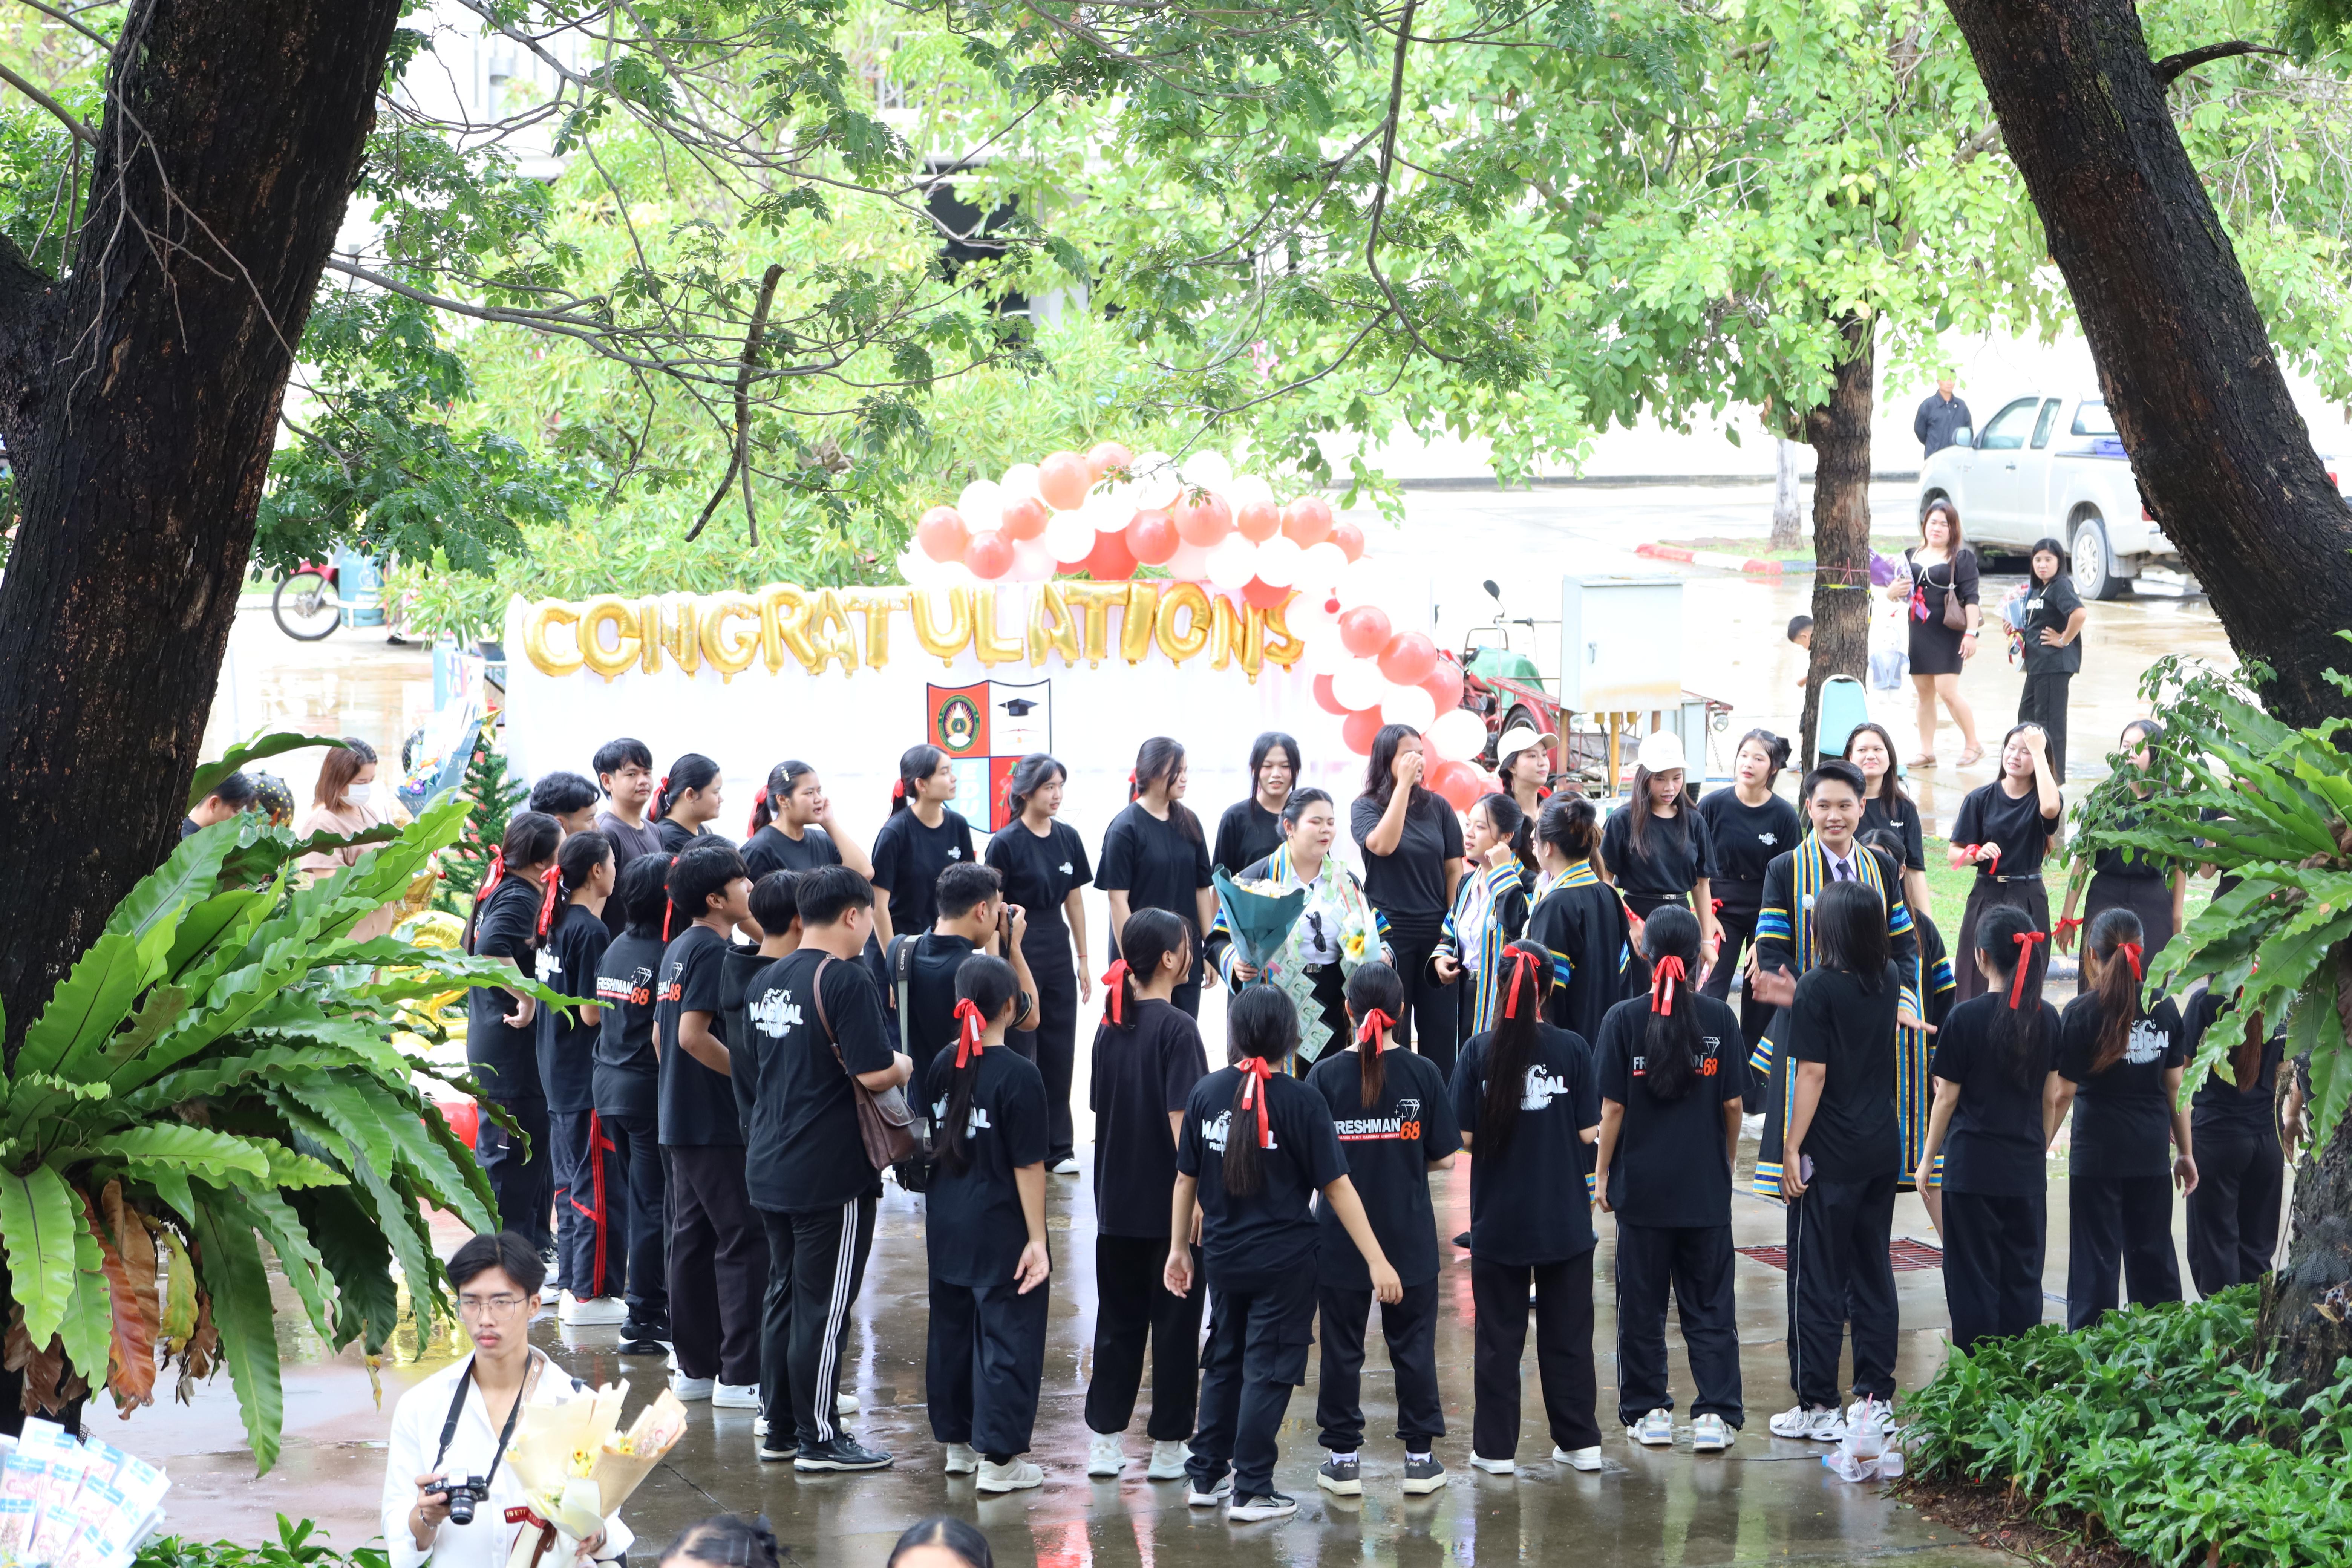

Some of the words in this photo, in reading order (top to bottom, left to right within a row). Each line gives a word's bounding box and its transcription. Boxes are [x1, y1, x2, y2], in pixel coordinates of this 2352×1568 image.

[959, 763, 979, 817] EDU
[597, 977, 634, 994] FRESHMAN
[631, 986, 650, 1005] 68
[669, 983, 681, 1001] 68
[1703, 1058, 1718, 1076] 68
[1334, 1118, 1400, 1135] RESHMAN
[1400, 1121, 1421, 1140] 68
